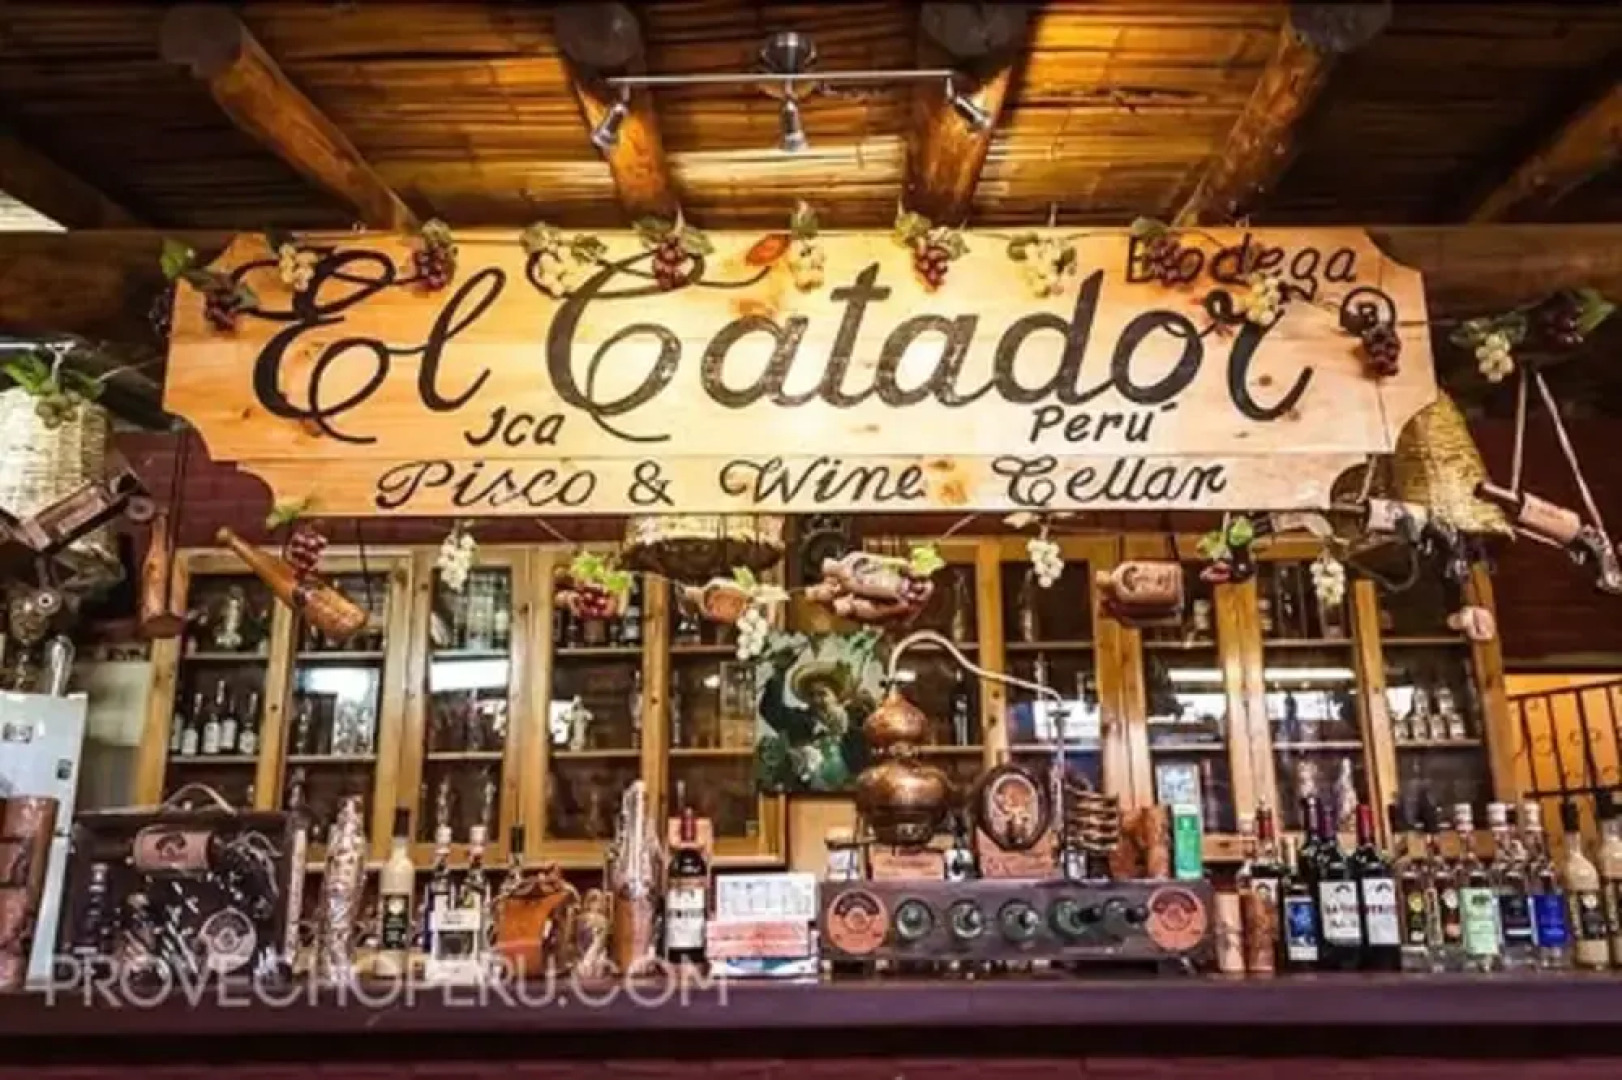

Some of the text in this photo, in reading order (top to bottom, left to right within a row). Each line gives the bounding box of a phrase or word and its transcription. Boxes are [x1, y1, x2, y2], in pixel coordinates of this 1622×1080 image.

[1126, 232, 1357, 301] Bodega
[231, 245, 1316, 445] El Catador
[1029, 402, 1179, 443] Perú
[375, 454, 1227, 508] Pisco & Wine Cellar
